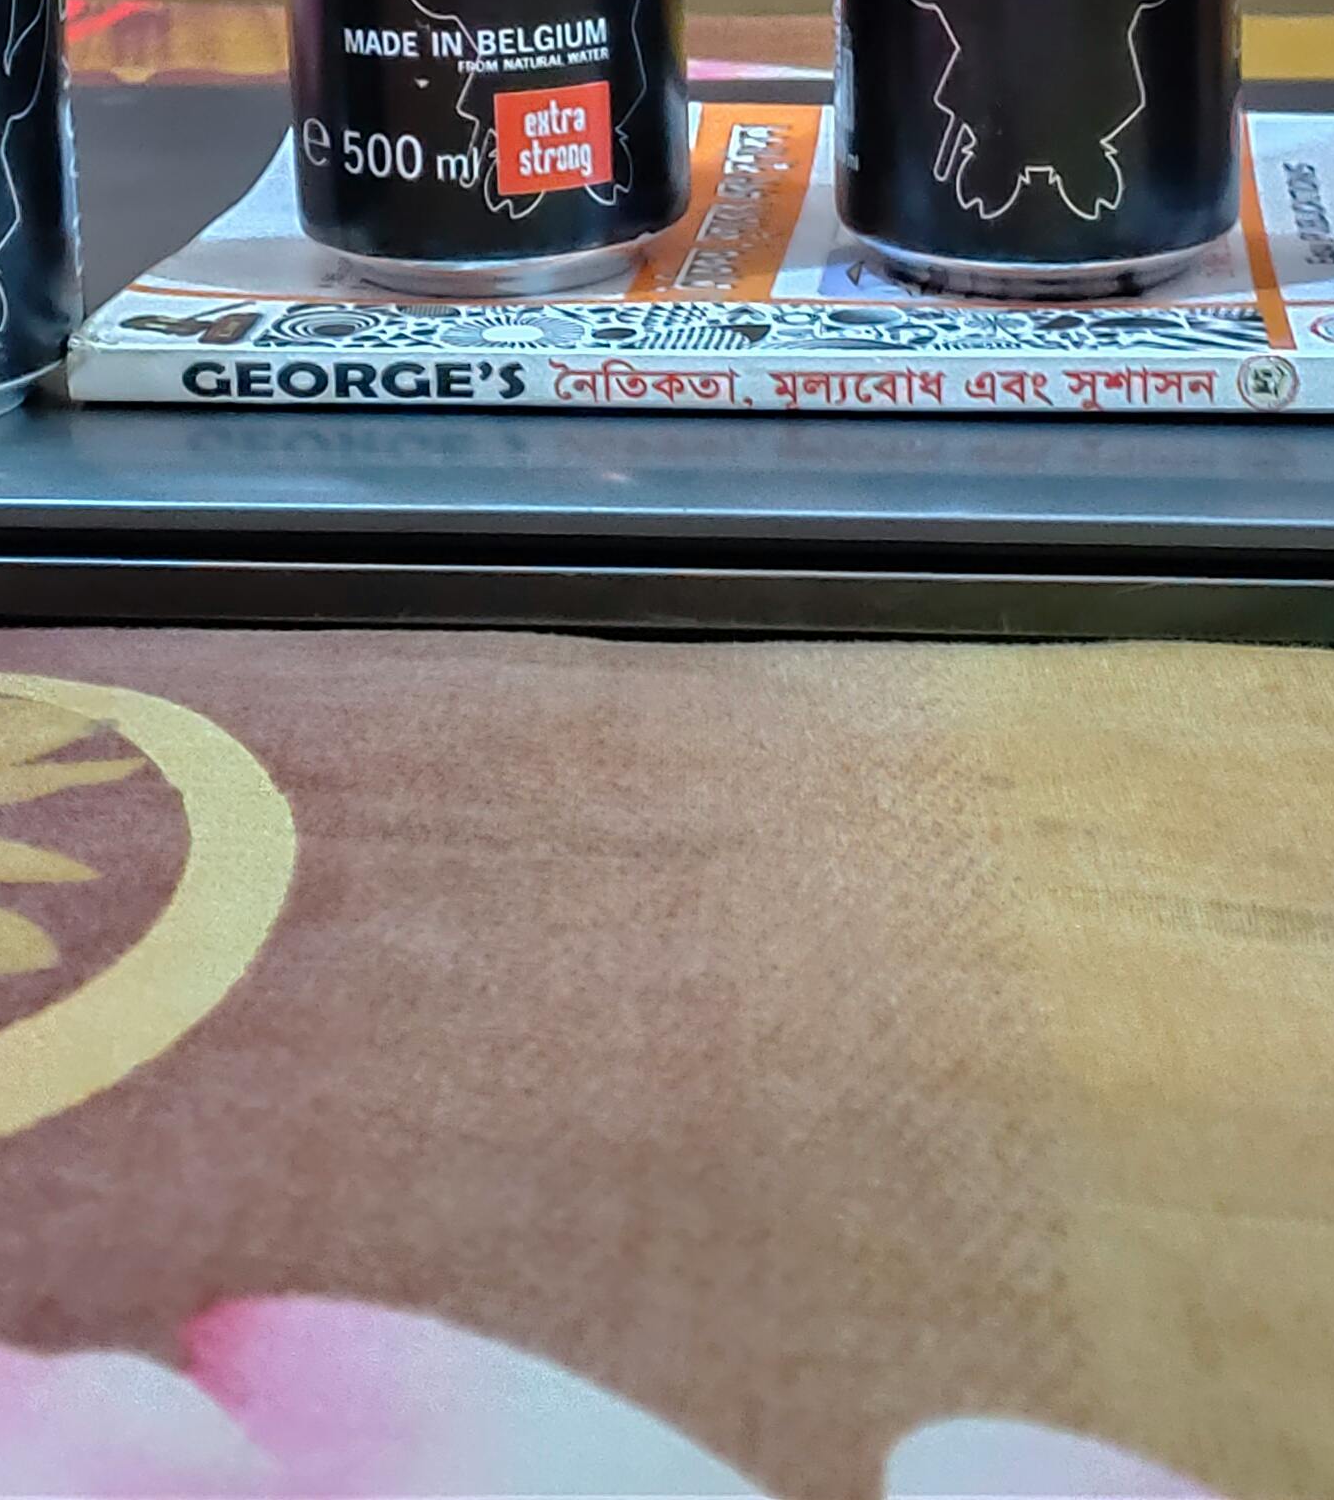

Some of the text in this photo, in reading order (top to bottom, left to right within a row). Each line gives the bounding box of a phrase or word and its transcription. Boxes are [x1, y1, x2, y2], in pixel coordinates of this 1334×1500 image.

[344, 18, 608, 58] MADE IN BELGIUM
[458, 46, 610, 74] FROM NATURAL WATER
[523, 100, 586, 137] extra
[343, 130, 423, 181] 500
[436, 151, 480, 181] ml
[519, 136, 594, 179] strong
[965, 370, 1054, 406] এবং
[1062, 365, 1219, 412] সুশাসন
